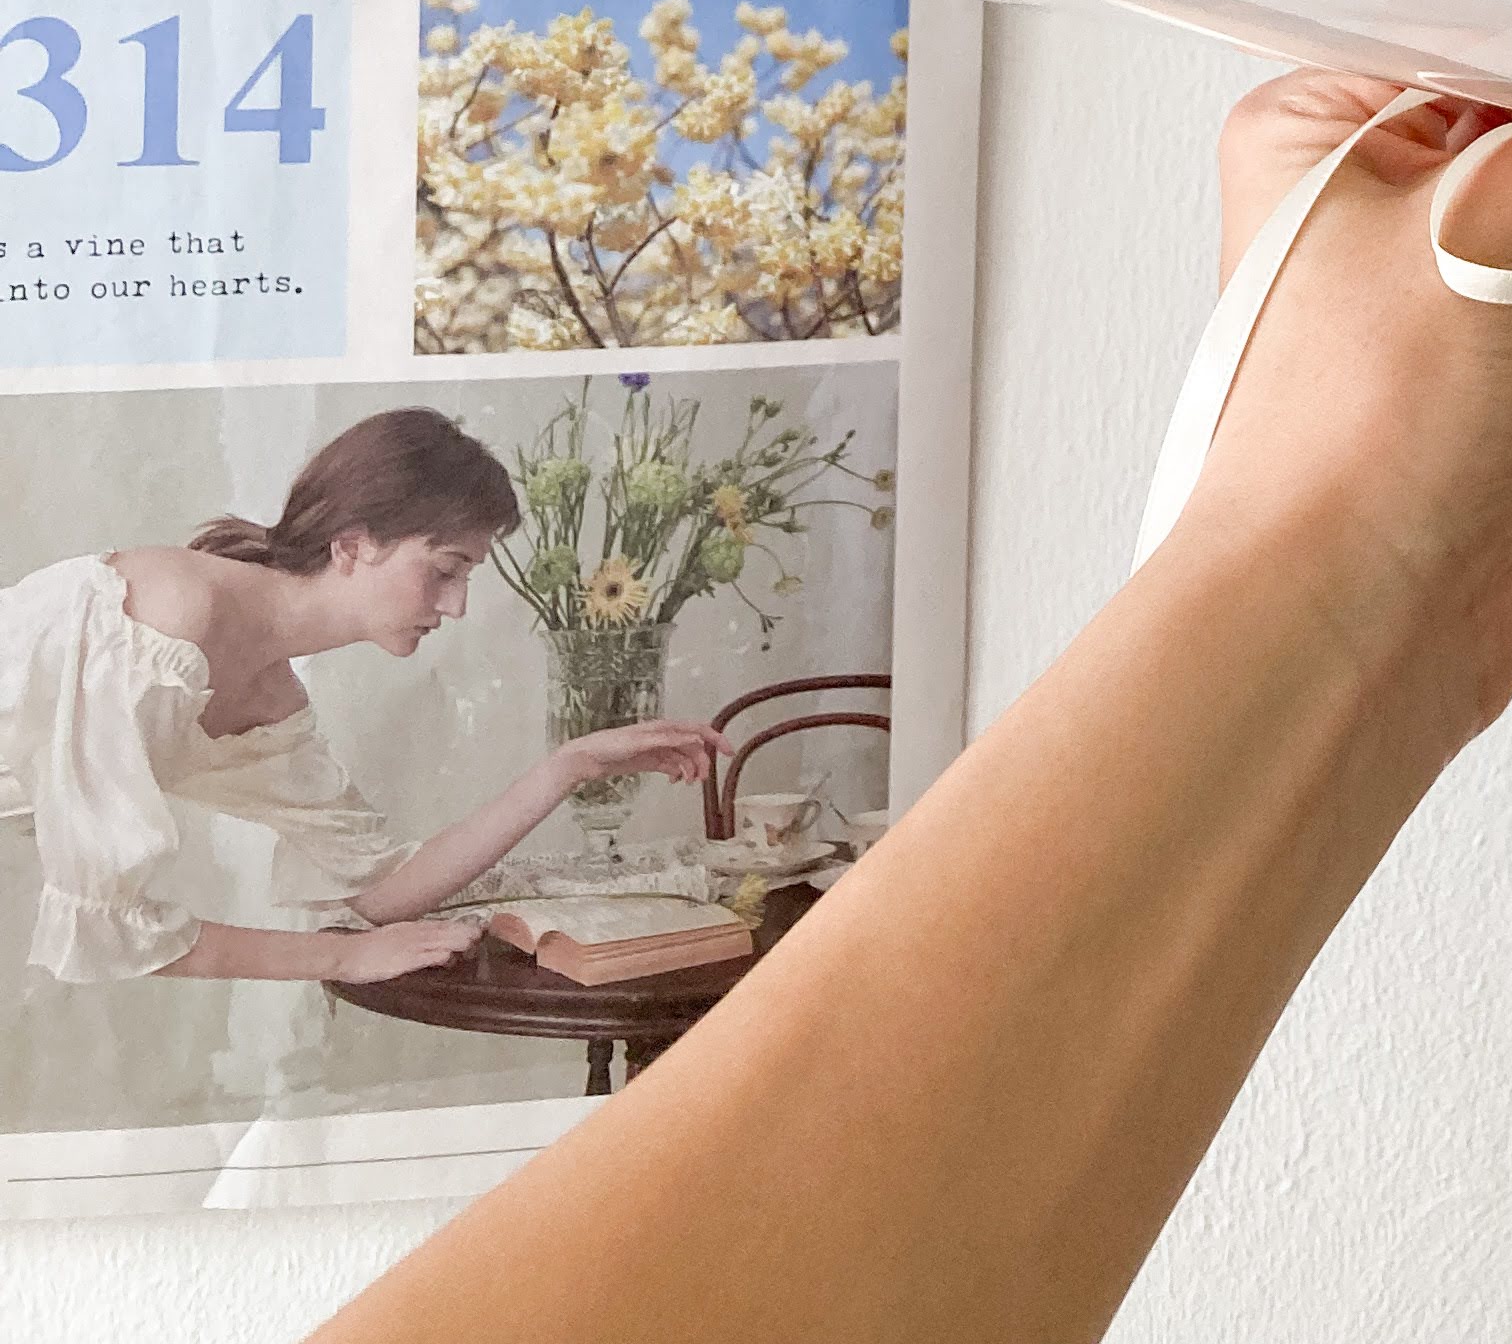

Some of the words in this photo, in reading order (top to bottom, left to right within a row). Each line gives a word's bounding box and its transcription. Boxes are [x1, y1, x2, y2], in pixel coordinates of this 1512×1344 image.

[0, 13, 327, 173] 314
[27, 242, 45, 258] a
[65, 234, 146, 258] vine
[168, 230, 245, 255] that
[0, 277, 71, 302] nto
[91, 278, 152, 300] our
[170, 273, 303, 297] hearts.
